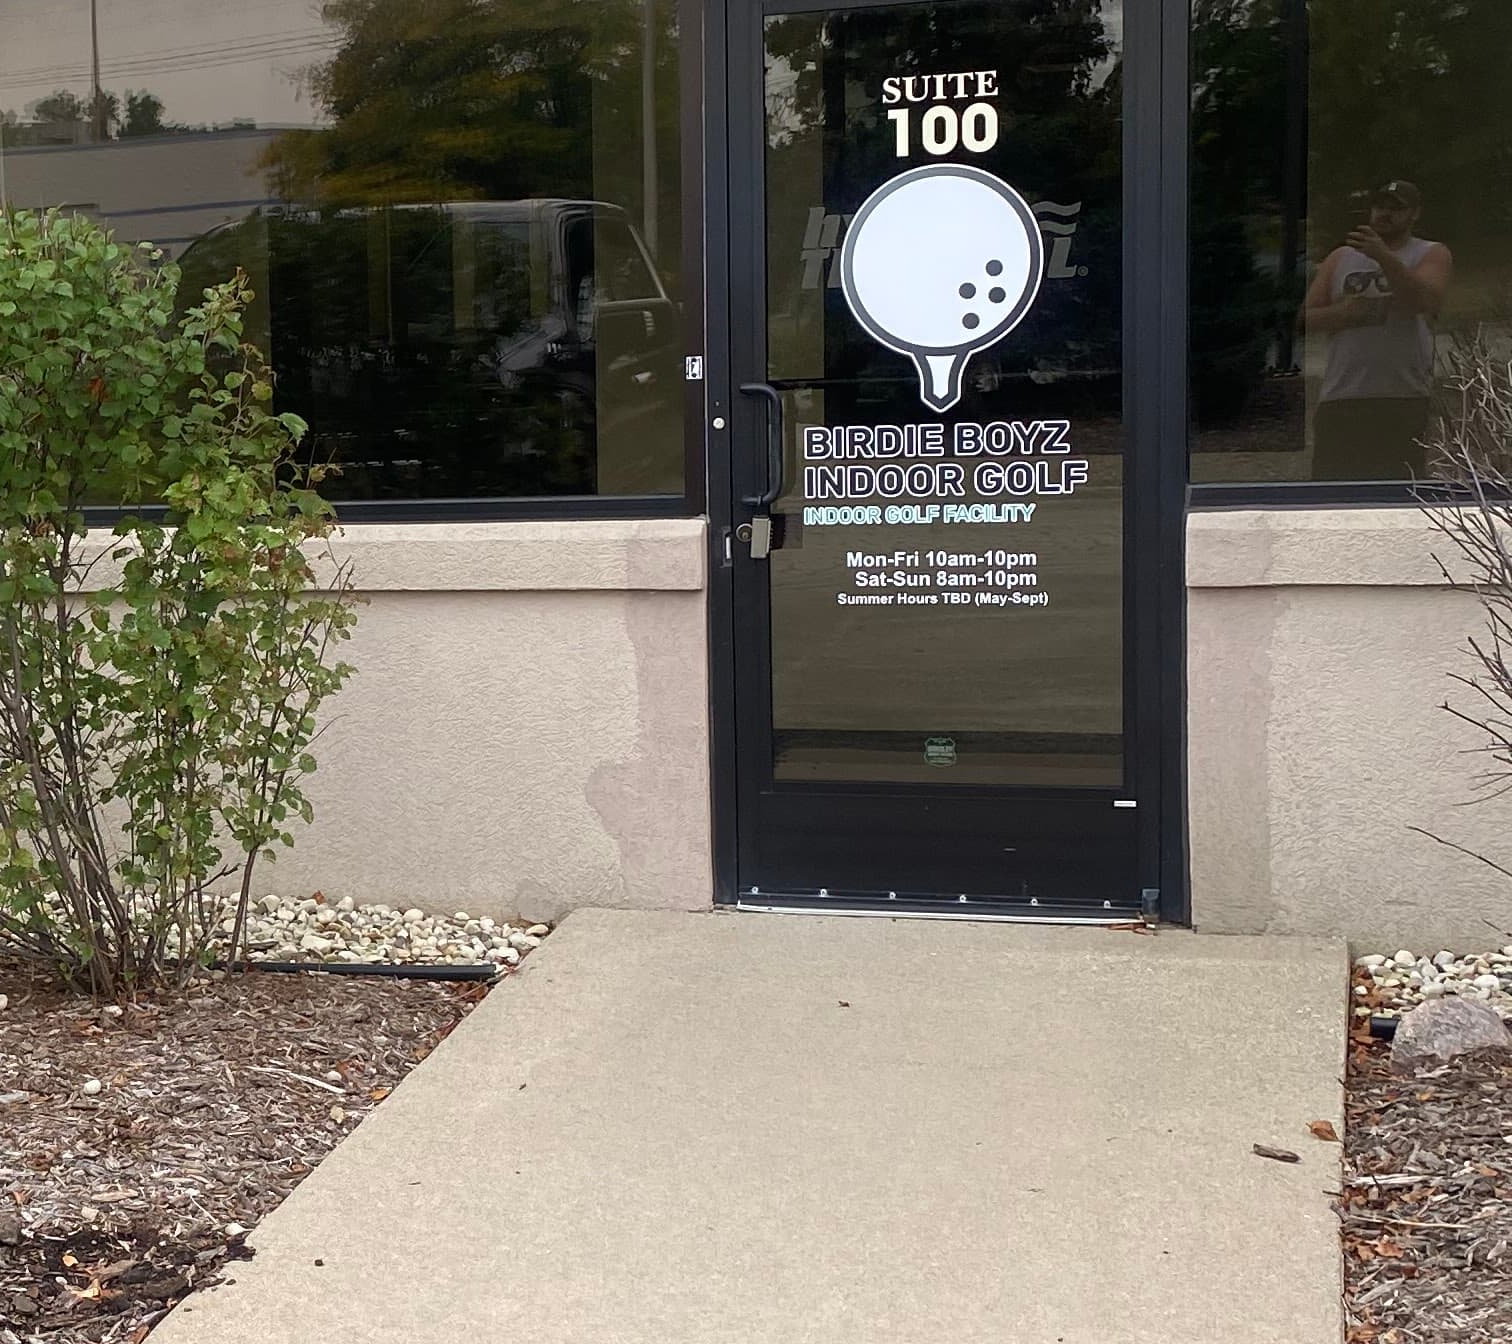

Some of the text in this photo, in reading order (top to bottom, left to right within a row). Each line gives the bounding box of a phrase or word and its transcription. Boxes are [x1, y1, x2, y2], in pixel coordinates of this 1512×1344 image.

[882, 70, 999, 104] SUITE
[887, 102, 999, 157] 100
[803, 419, 1071, 460] BIRDIE BOYZ
[803, 459, 1089, 500] INDOOR GOLF
[803, 502, 1036, 526] INDOOR GOLF FACILITY
[846, 549, 1037, 570] Mon-Fri 10am-10pm
[855, 569, 1037, 590] Sat-Sun 8am-10pm
[837, 591, 1049, 608] Summer Hours TBD (May-Sept)
